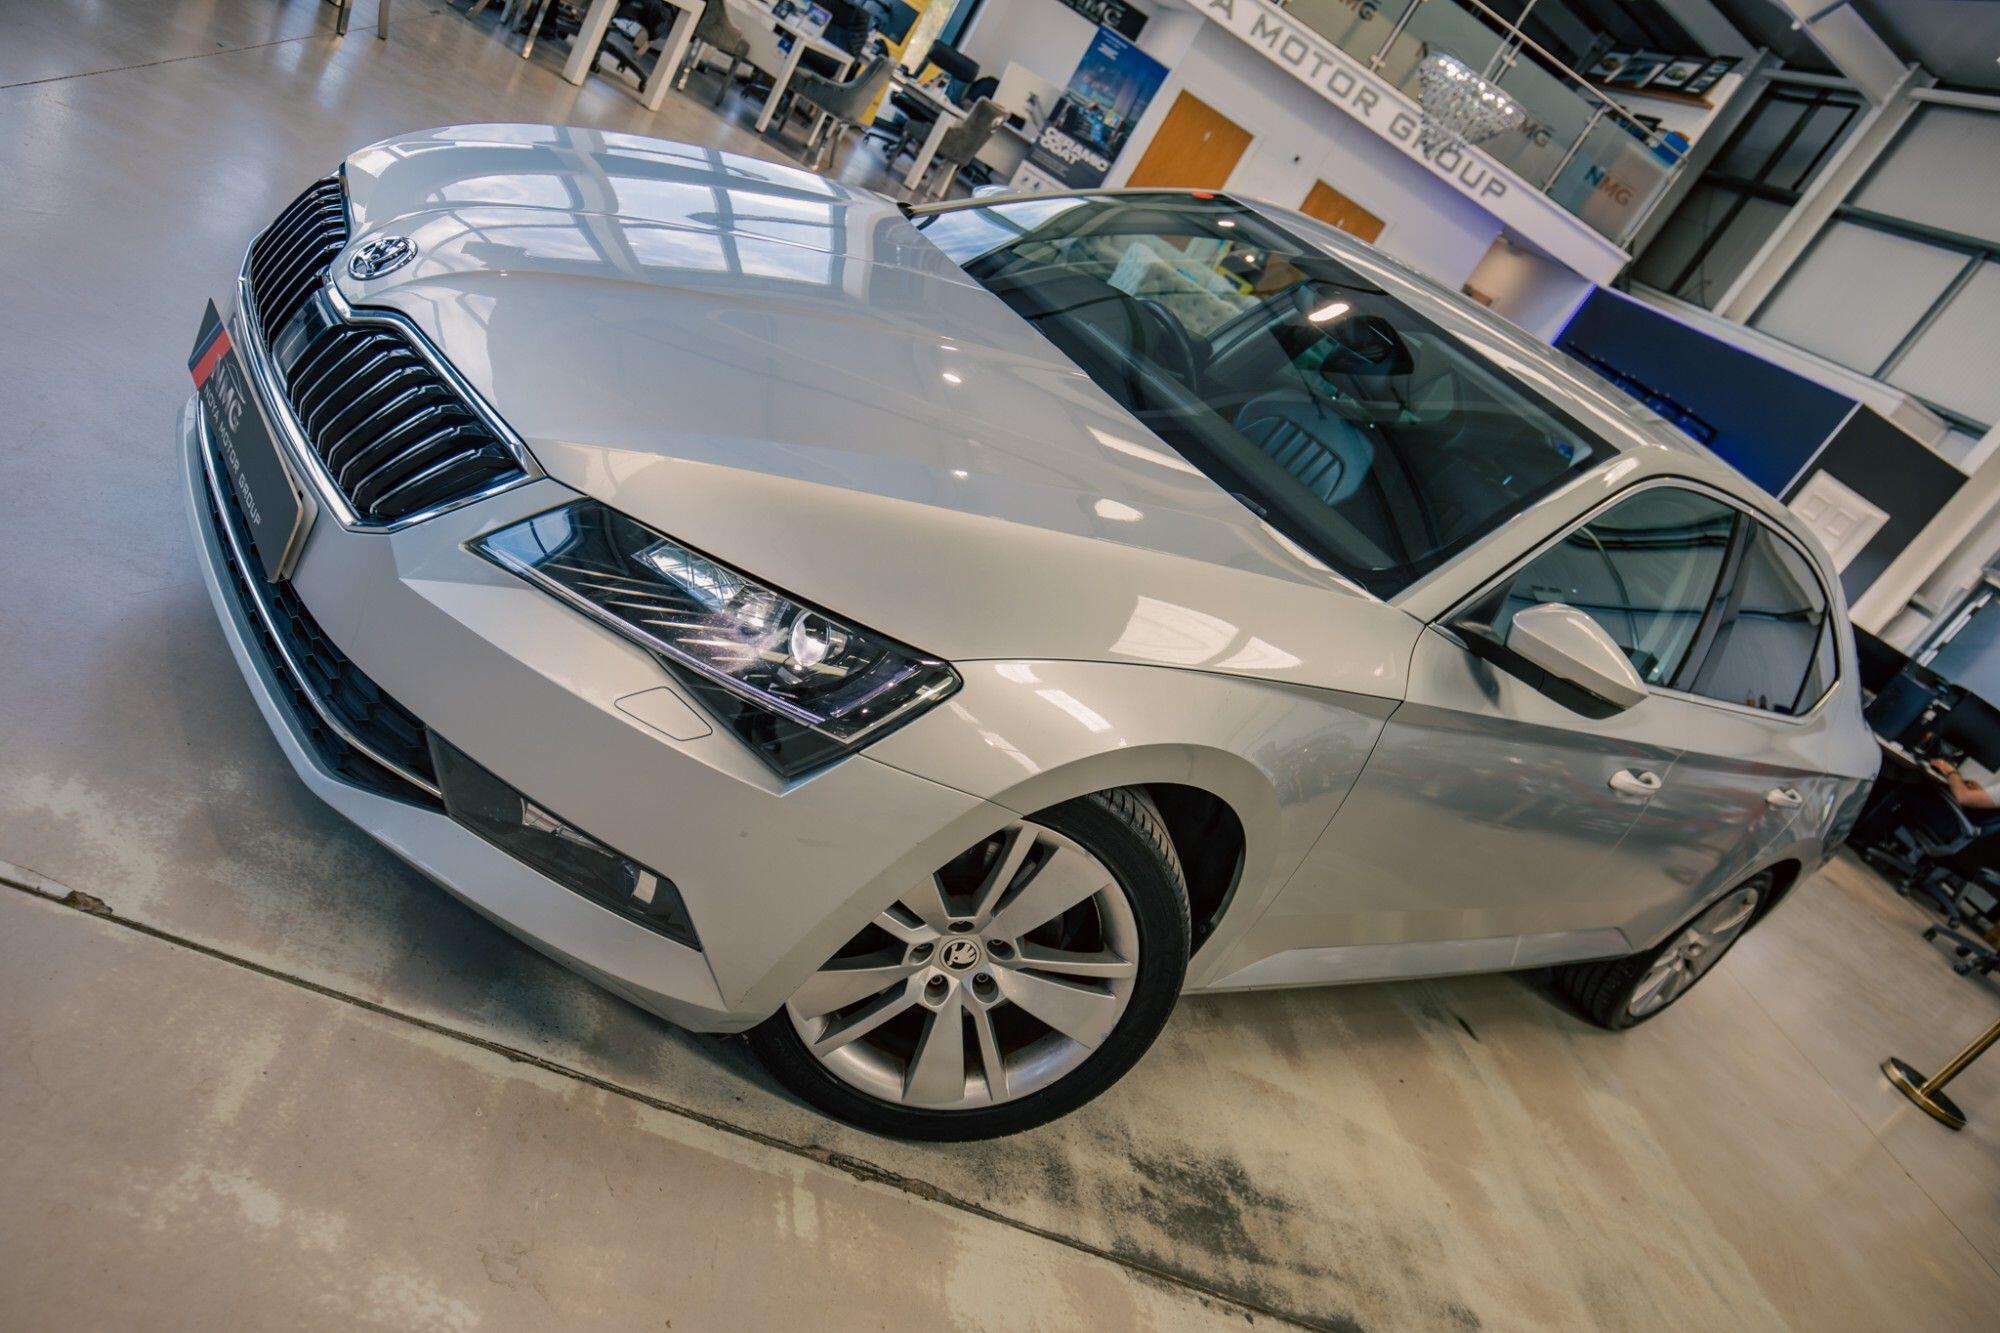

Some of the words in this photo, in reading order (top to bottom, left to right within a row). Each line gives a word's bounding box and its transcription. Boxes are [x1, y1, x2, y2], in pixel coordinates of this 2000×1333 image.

[1250, 13, 1380, 117] MOTOR
[1584, 165, 1633, 206] NMG
[219, 421, 240, 475] MOTOR
[238, 472, 262, 526] GROUP
